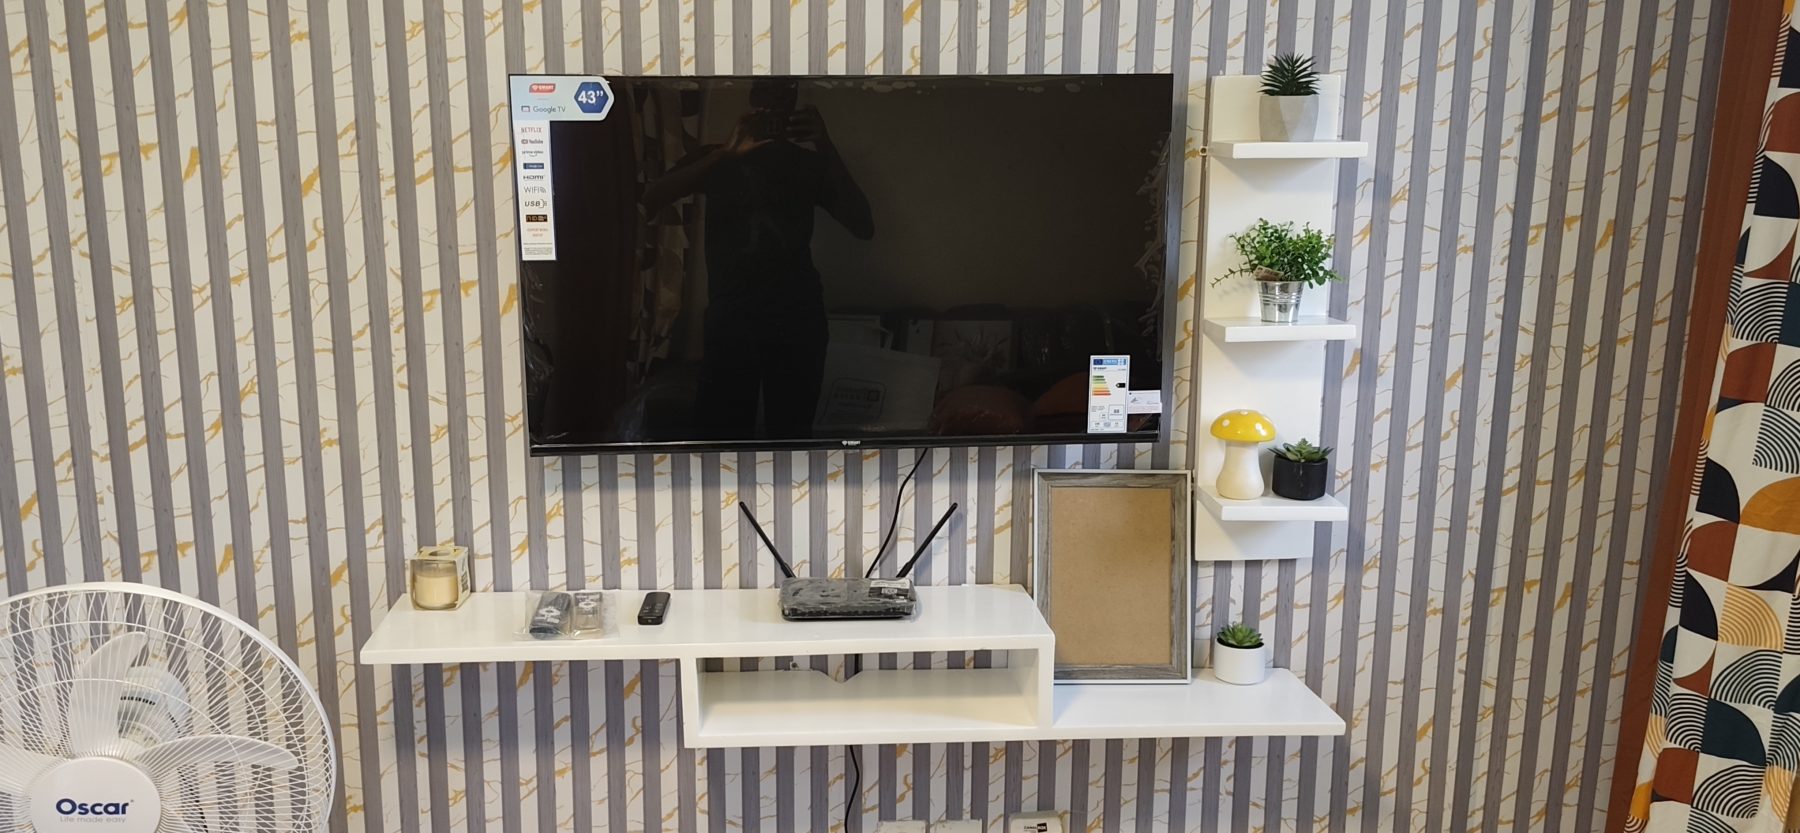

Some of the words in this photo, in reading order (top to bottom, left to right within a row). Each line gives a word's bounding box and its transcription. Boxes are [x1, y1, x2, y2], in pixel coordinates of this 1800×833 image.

[533, 106, 556, 114] Google
[56, 798, 129, 815] Oscar
[106, 816, 126, 824] easy
